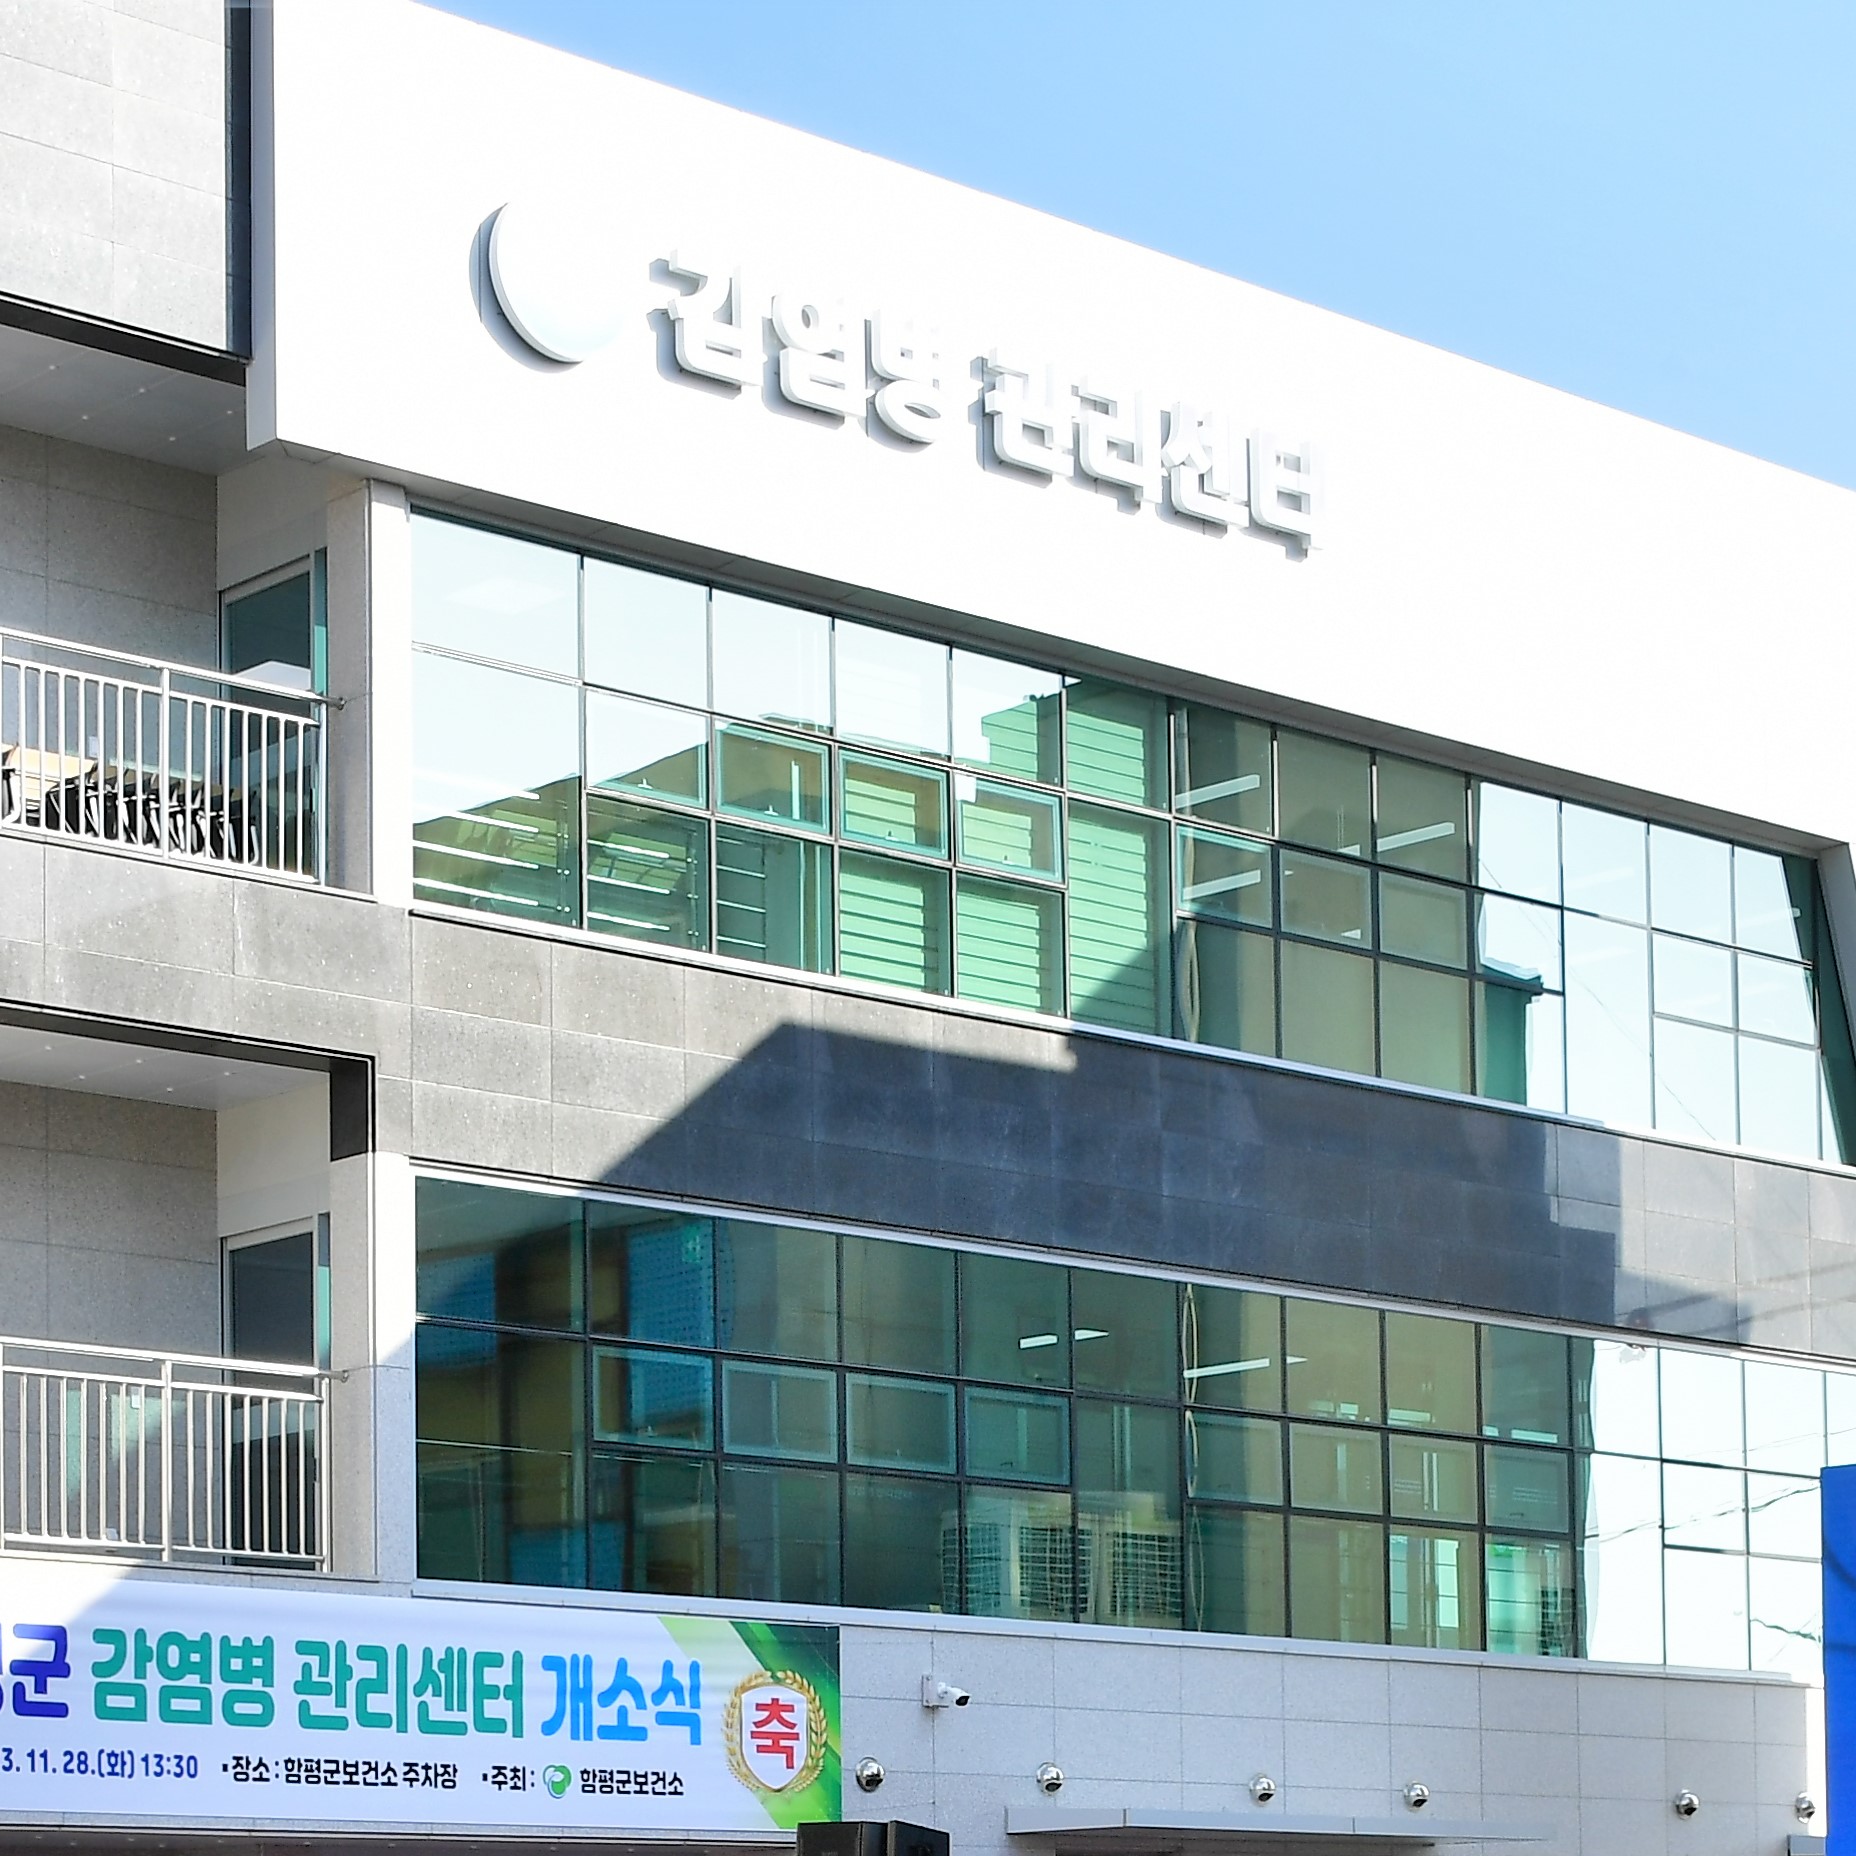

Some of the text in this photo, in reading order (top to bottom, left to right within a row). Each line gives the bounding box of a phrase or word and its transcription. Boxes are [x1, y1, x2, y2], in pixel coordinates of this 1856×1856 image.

[650, 250, 1324, 560] 감염병 관리센터
[91, 1627, 275, 1728] 감염병
[293, 1639, 524, 1739] 관리센터
[540, 1654, 702, 1745] 개소식
[141, 1753, 199, 1779] 13:30
[749, 1697, 801, 1770] 축
[580, 1767, 685, 1797] 함평군보건소
